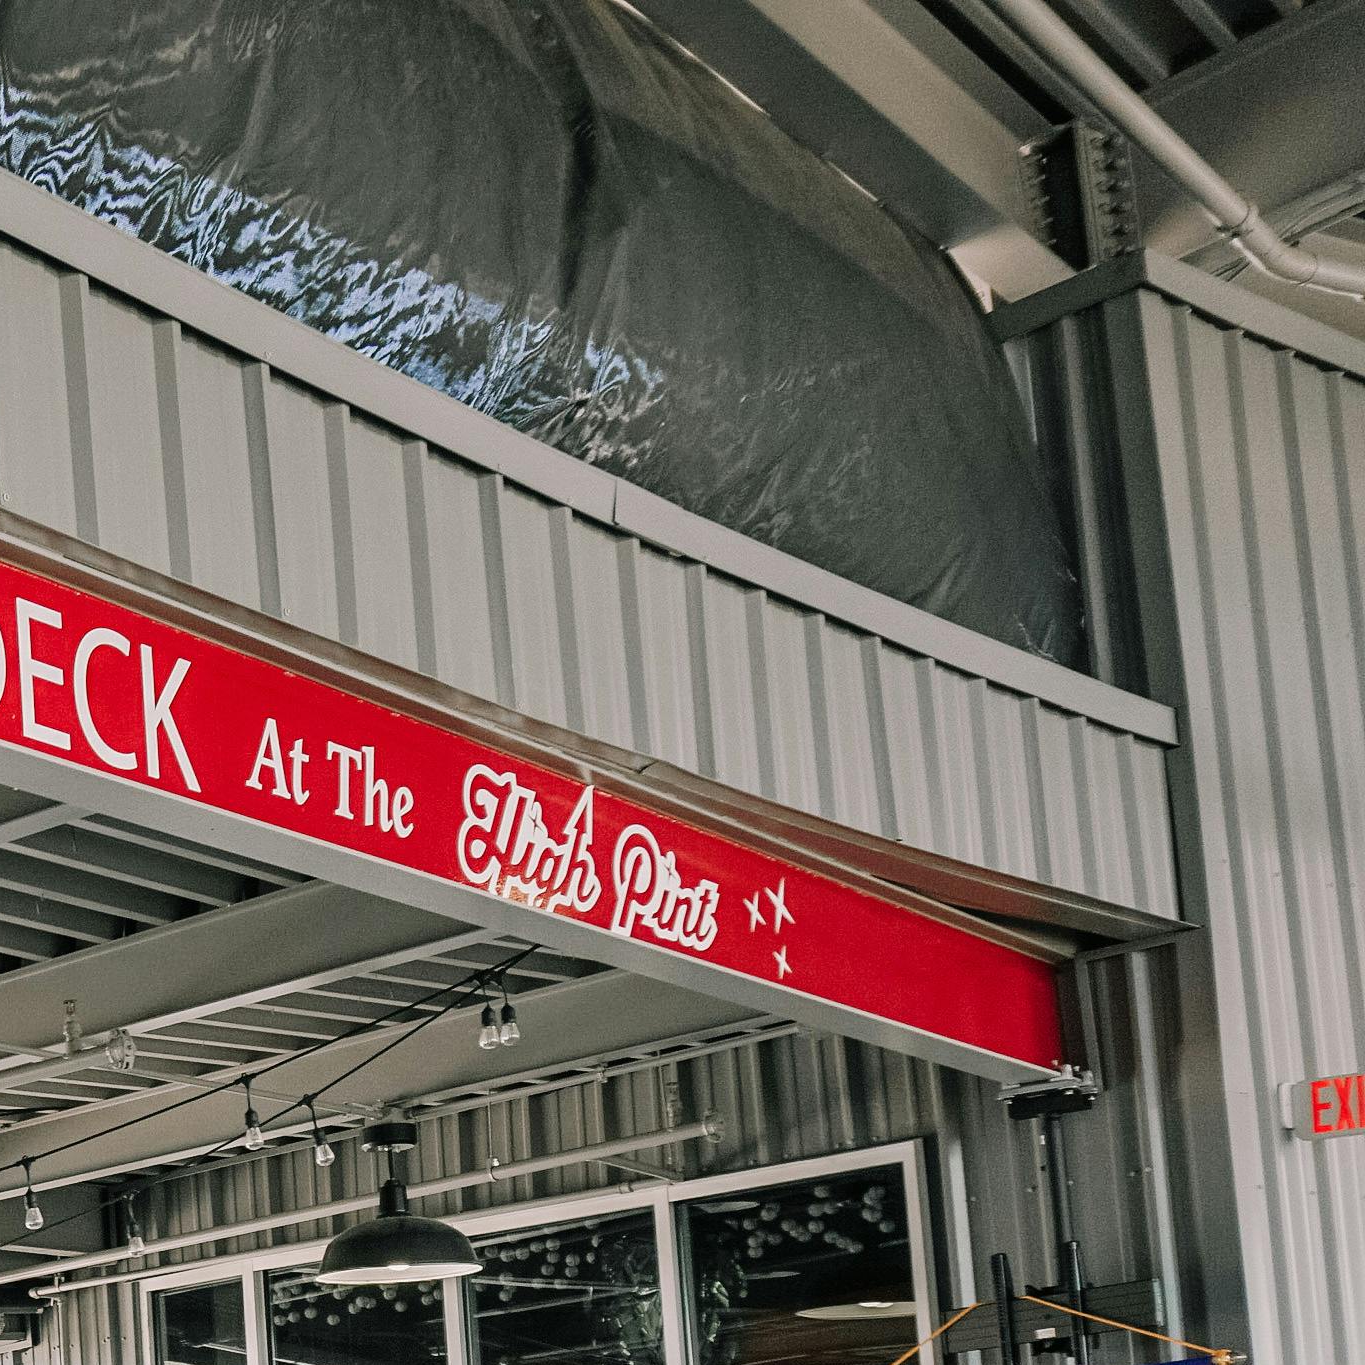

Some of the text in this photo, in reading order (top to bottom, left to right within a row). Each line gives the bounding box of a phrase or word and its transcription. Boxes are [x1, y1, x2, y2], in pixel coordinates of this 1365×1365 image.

[245, 718, 309, 805] At
[326, 741, 414, 838] The
[611, 824, 720, 951] Pint
